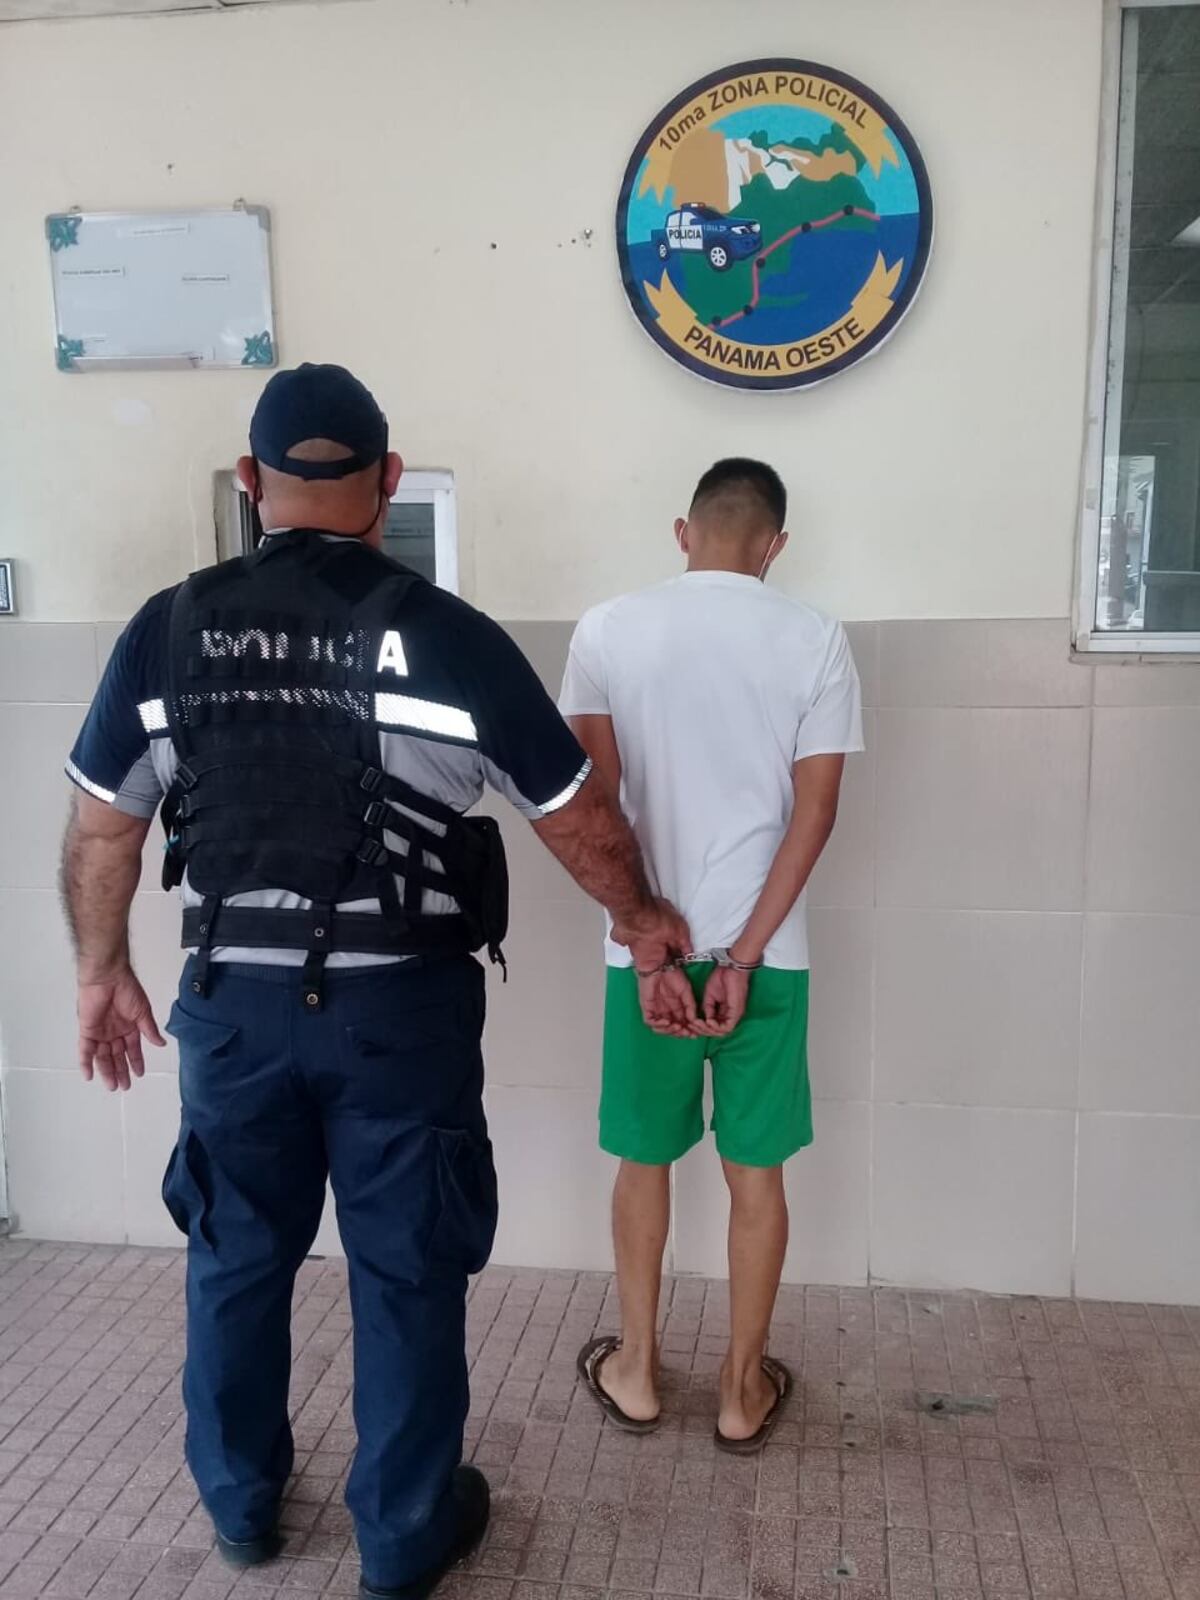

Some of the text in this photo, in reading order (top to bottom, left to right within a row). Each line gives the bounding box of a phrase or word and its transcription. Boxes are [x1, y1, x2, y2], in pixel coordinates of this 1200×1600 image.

[659, 76, 868, 152] 10ma ZONA POLICIAL
[668, 229, 701, 239] POLICIA
[684, 317, 864, 370] PANAMA OESTE
